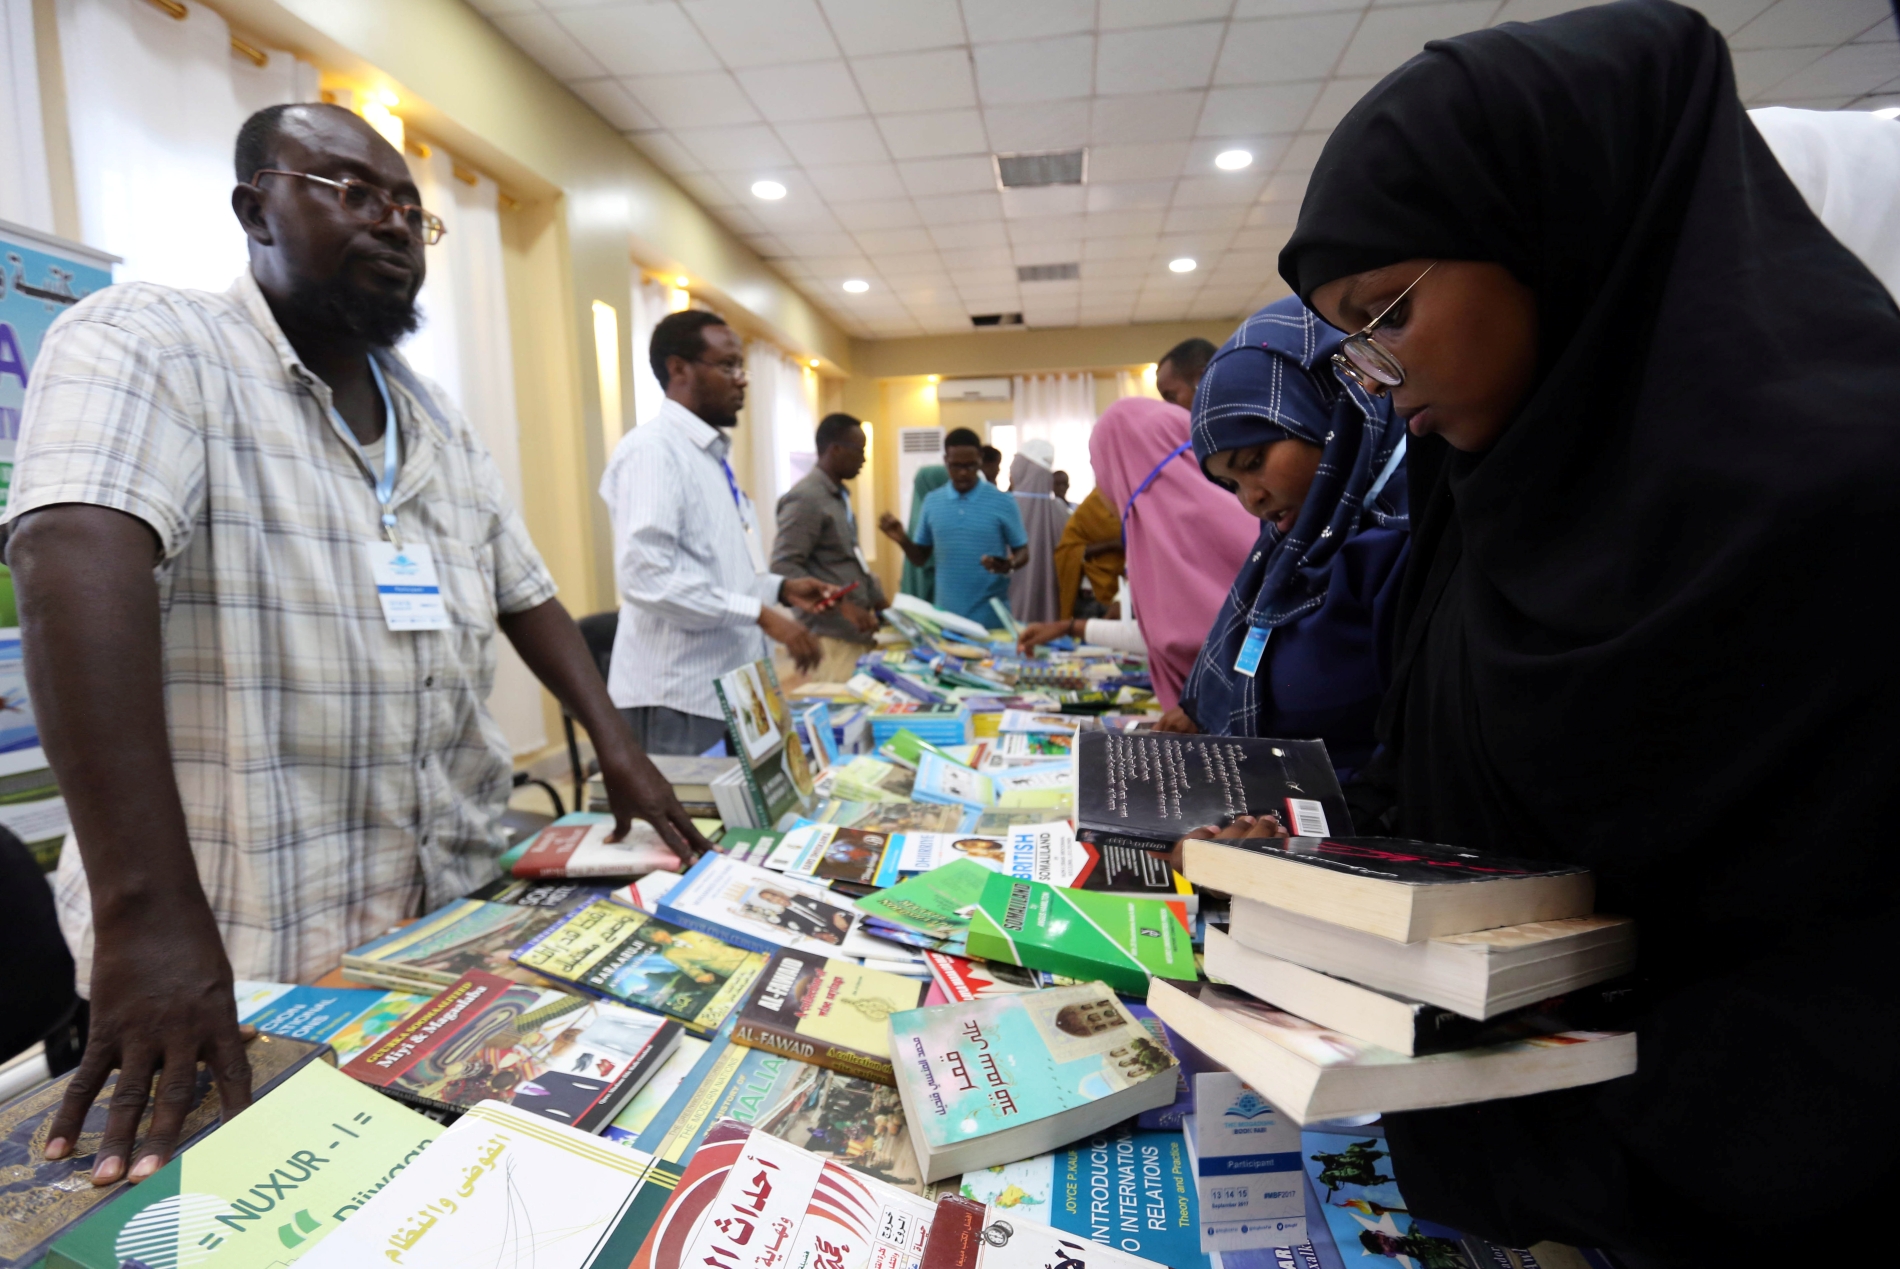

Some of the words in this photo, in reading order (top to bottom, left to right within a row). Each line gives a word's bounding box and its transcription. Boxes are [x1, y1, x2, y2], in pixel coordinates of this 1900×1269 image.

[1011, 833, 1035, 881] BRITISH
[1038, 832, 1051, 881] SOMALILAND
[1003, 883, 1031, 931] SOMALILAND
[590, 939, 647, 986] BARAARUJI
[757, 956, 804, 1012] AL-FAWAID
[801, 978, 823, 1012] collection
[826, 976, 845, 1001] sayings
[376, 1042, 415, 1068] Miyi
[409, 1033, 429, 1044] &
[737, 1026, 815, 1058] AL-FAWAID
[837, 1051, 881, 1072] collection
[913, 1037, 926, 1057] محمد
[730, 1056, 788, 1122] MALIA
[939, 1051, 981, 1091] قمر
[668, 1123, 680, 1137] THE
[678, 1088, 706, 1128] GREENWOOD
[679, 1126, 698, 1141] THE
[694, 1087, 720, 1129] MODERN
[715, 1057, 739, 1090] NATIONS
[716, 1085, 740, 1123] HISTORY
[736, 1073, 747, 1085] OF
[456, 1133, 512, 1198] الفوضى
[1067, 1150, 1079, 1181] P.KAUF
[1171, 1142, 1184, 1175] Practice
[1227, 1159, 1275, 1169] Participant
[214, 1150, 330, 1232] NUXUR
[713, 1155, 781, 1246] أحداث
[1065, 1182, 1078, 1214] JOYCE
[1091, 1136, 1111, 1244] INTRODUCIO
[1141, 1146, 1167, 1231] RELATIONS
[1173, 1176, 1186, 1194] and
[1212, 1191, 1222, 1199] 13
[1225, 1190, 1235, 1199] 14
[1238, 1190, 1248, 1198] 15
[1212, 1202, 1237, 1210] September
[1264, 1190, 1297, 1199] #MBF2017
[385, 1197, 459, 1265] والنظام
[881, 1211, 894, 1239] خروج
[1178, 1195, 1191, 1228] Theory
[754, 1217, 794, 1268] ونهاية
[913, 1225, 930, 1252] حياة
[1121, 1238, 1142, 1252] O
